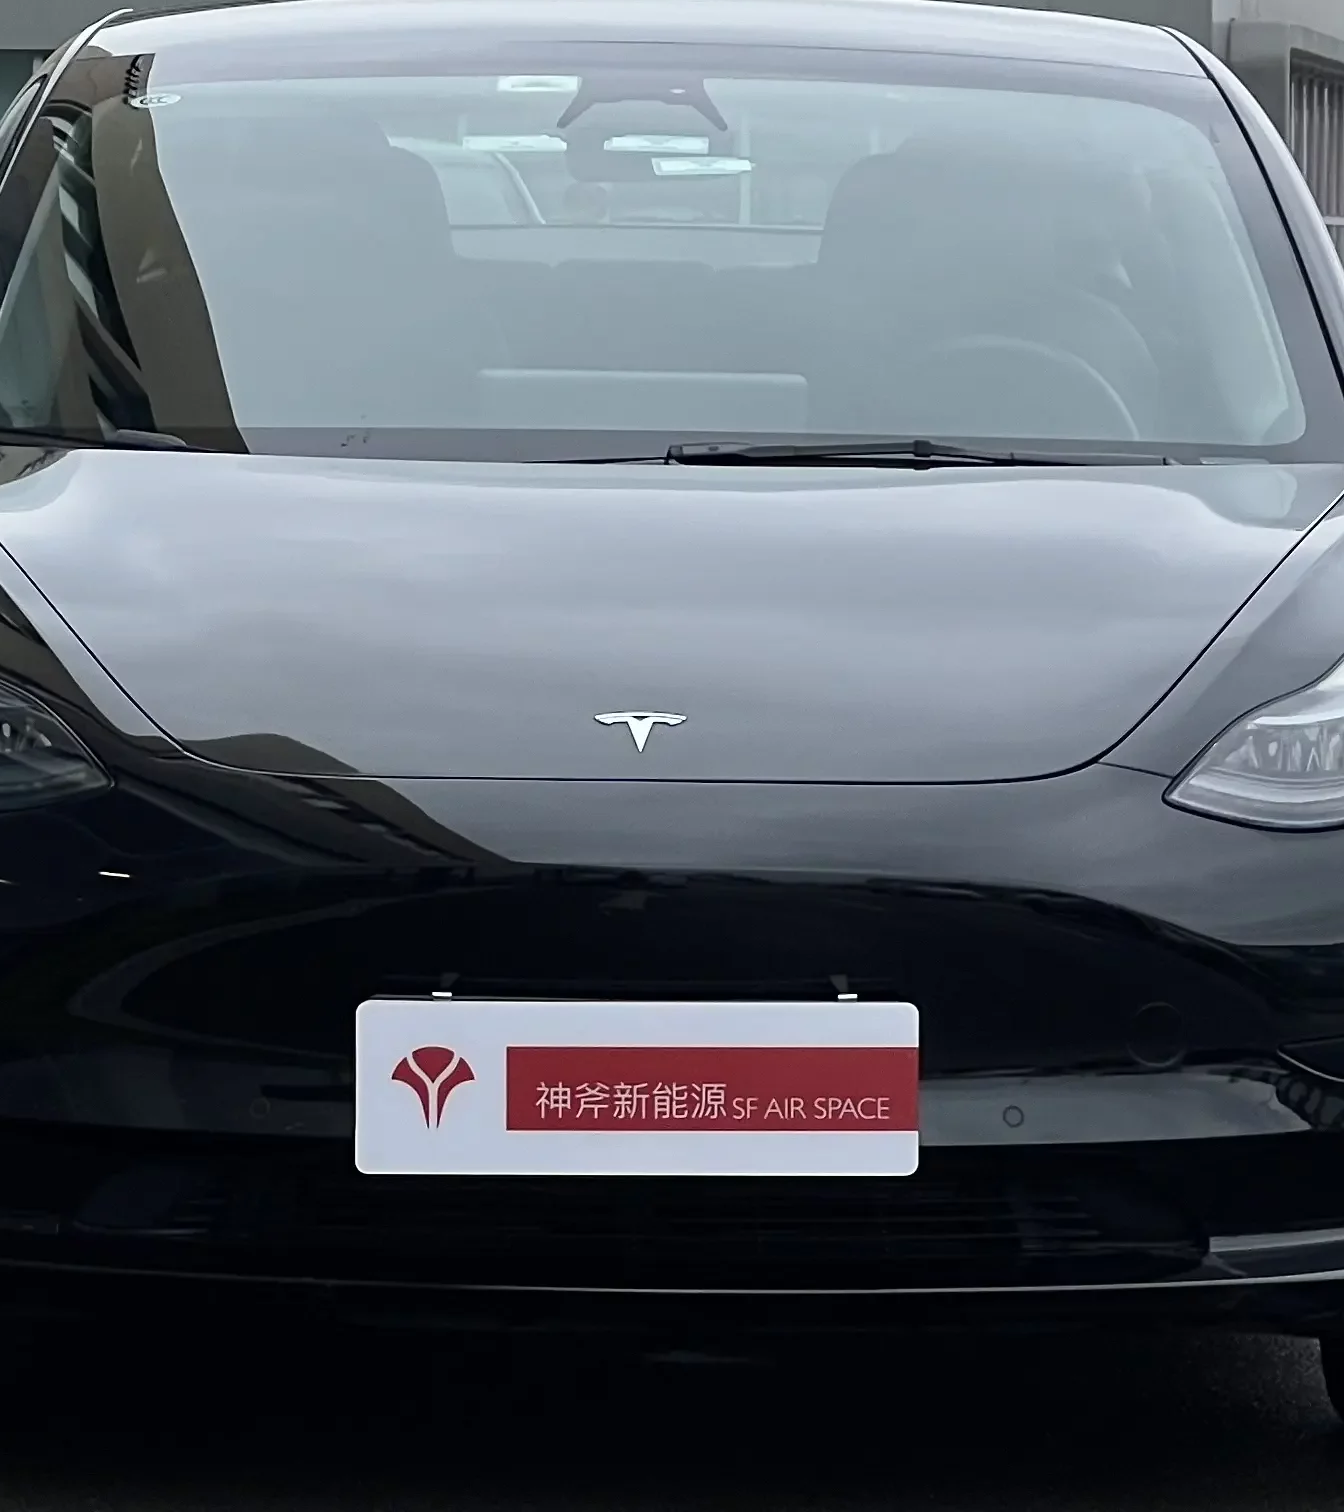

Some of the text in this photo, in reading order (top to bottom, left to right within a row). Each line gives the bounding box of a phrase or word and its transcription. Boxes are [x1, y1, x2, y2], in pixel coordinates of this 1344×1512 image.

[535, 1081, 727, 1120] 神斧新能源
[732, 1097, 891, 1120] SF AIR SPACE
